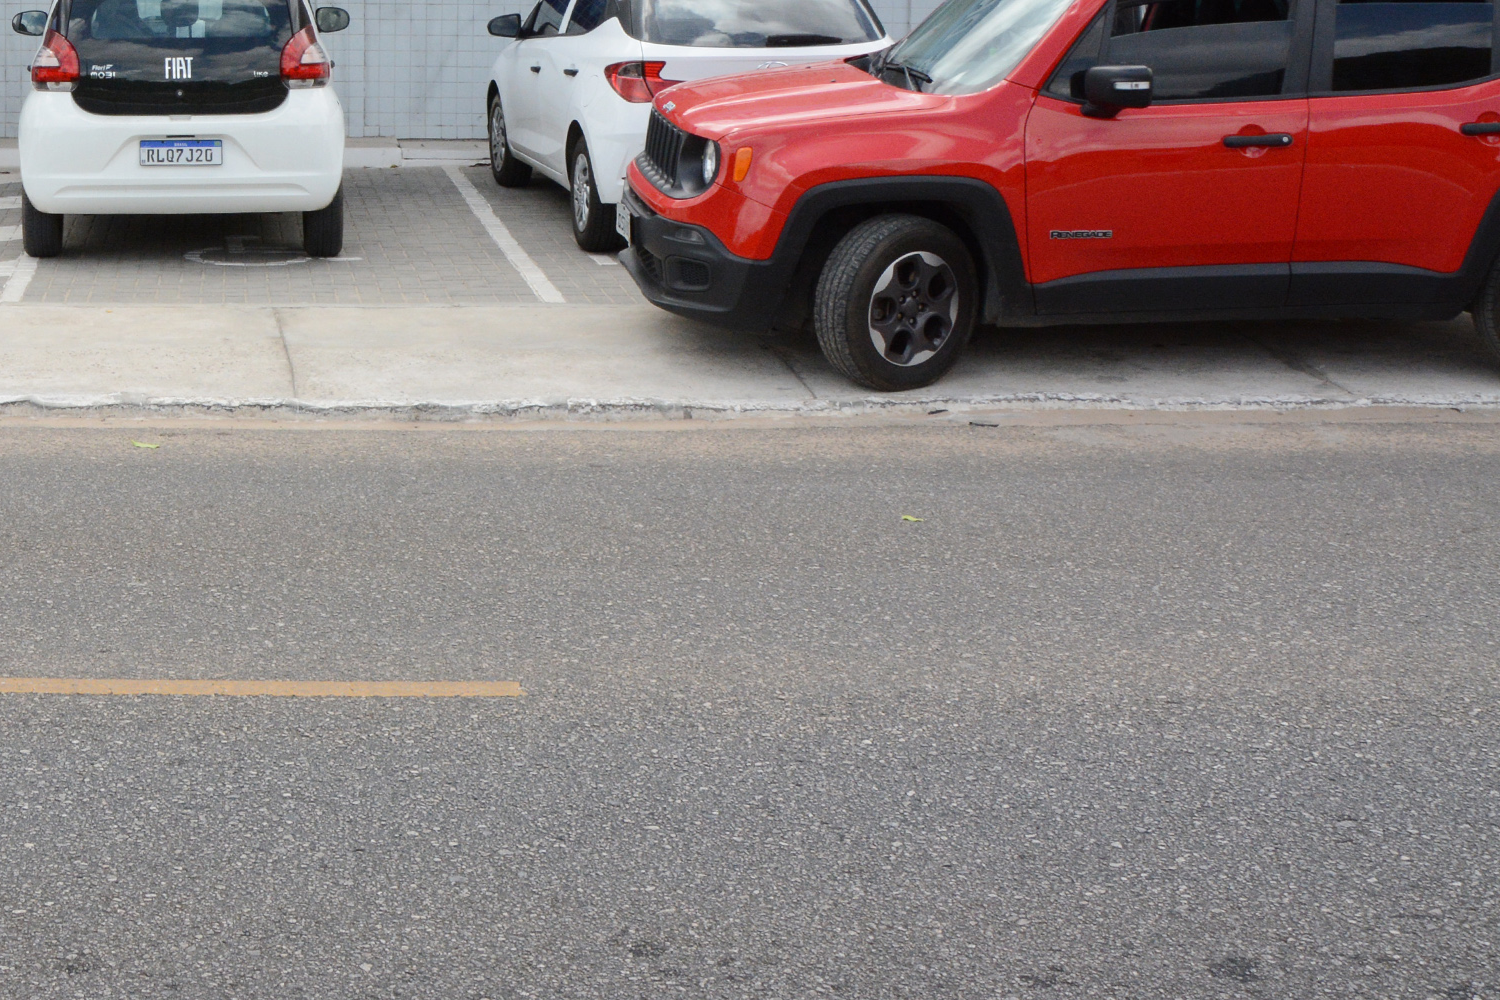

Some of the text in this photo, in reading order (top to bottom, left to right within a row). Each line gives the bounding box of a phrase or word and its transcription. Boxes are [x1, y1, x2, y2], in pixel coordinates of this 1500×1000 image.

[165, 57, 193, 80] FIAT
[147, 148, 213, 163] RLQ7J20
[1050, 230, 1113, 239] RENEGADE
